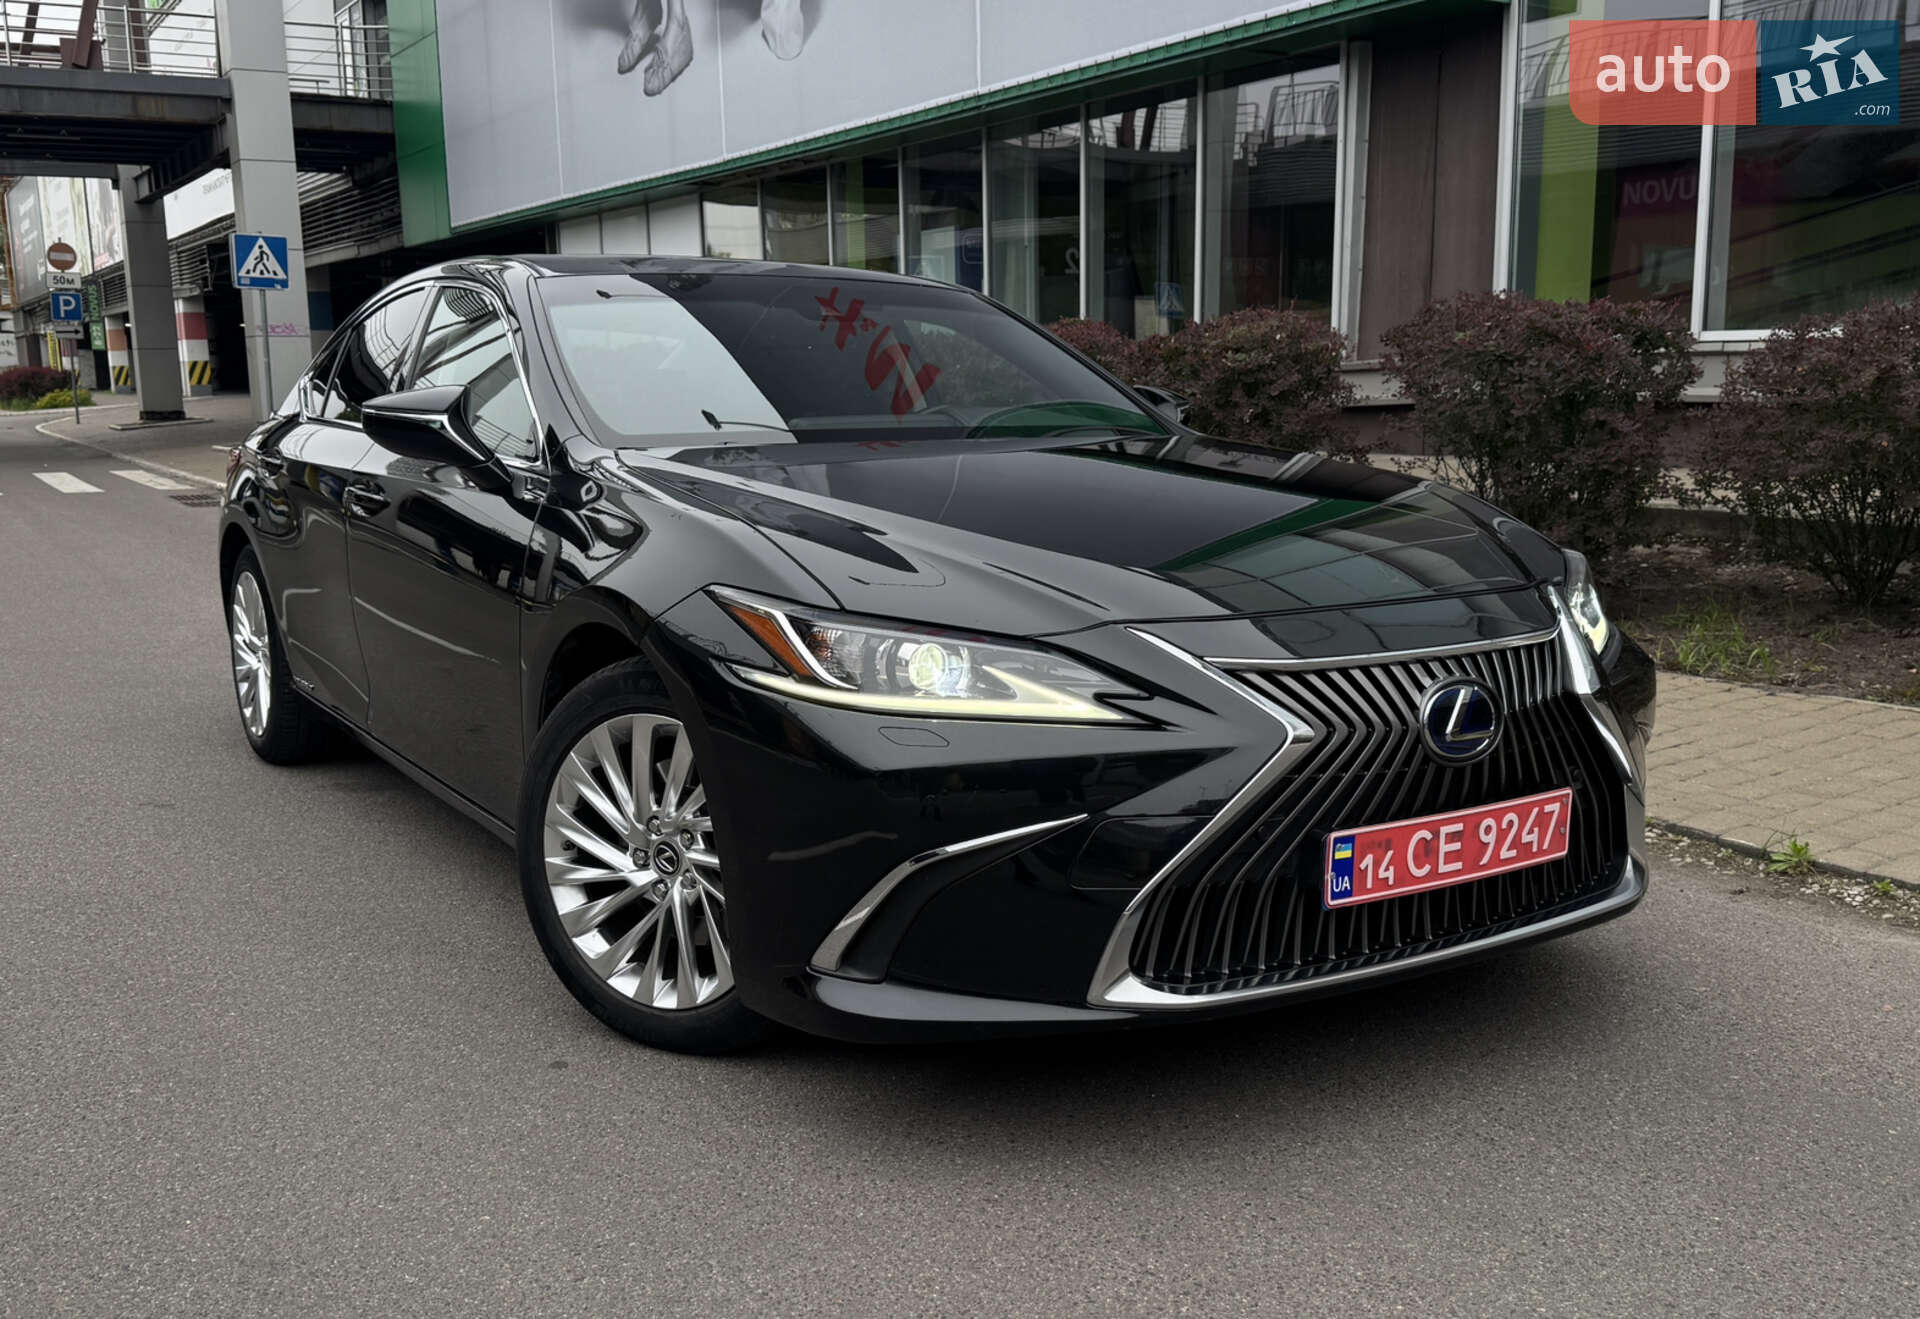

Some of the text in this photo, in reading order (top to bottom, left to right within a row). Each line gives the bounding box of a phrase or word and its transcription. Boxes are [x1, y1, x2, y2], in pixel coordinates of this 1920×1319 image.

[58, 295, 77, 318] P
[88, 285, 100, 321] NOVUS
[1359, 801, 1562, 889] 14 CE 9247
[1332, 875, 1351, 893] UA
